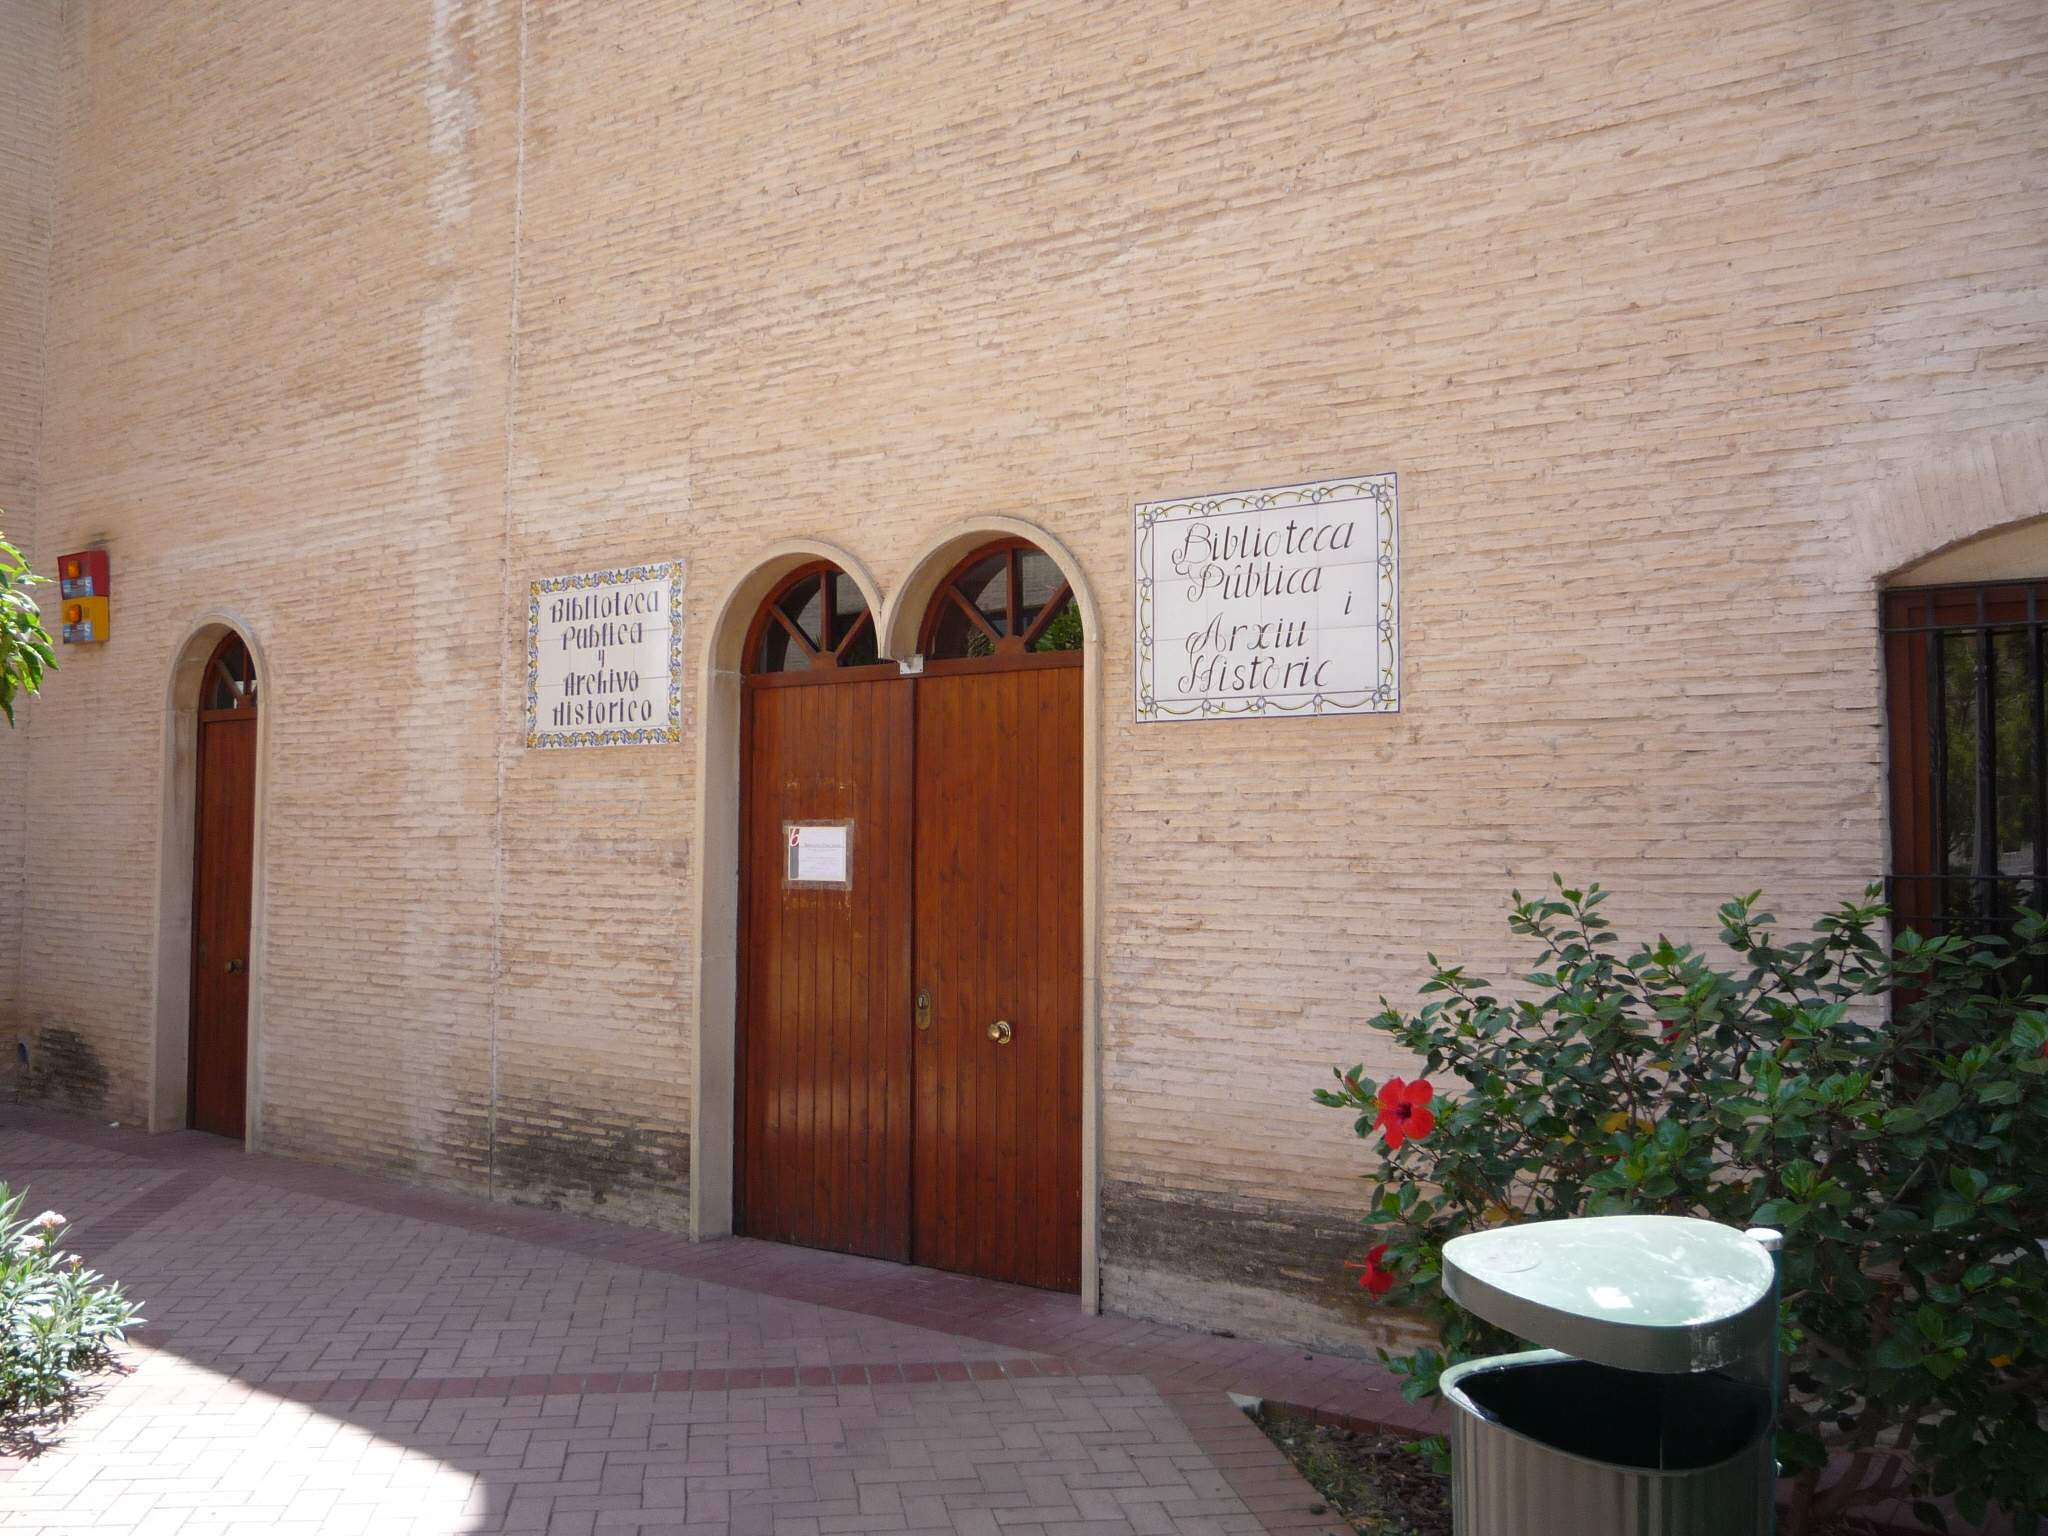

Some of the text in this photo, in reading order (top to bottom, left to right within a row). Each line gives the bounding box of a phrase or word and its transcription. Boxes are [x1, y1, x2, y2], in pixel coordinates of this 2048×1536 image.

[1172, 520, 1355, 564] Biblioteca
[549, 590, 658, 623] Biblioteca
[1344, 591, 1353, 615] i
[1185, 612, 1307, 653] Arxiu
[598, 649, 605, 668] y
[563, 669, 639, 696] Archivo
[552, 698, 652, 726] Historico
